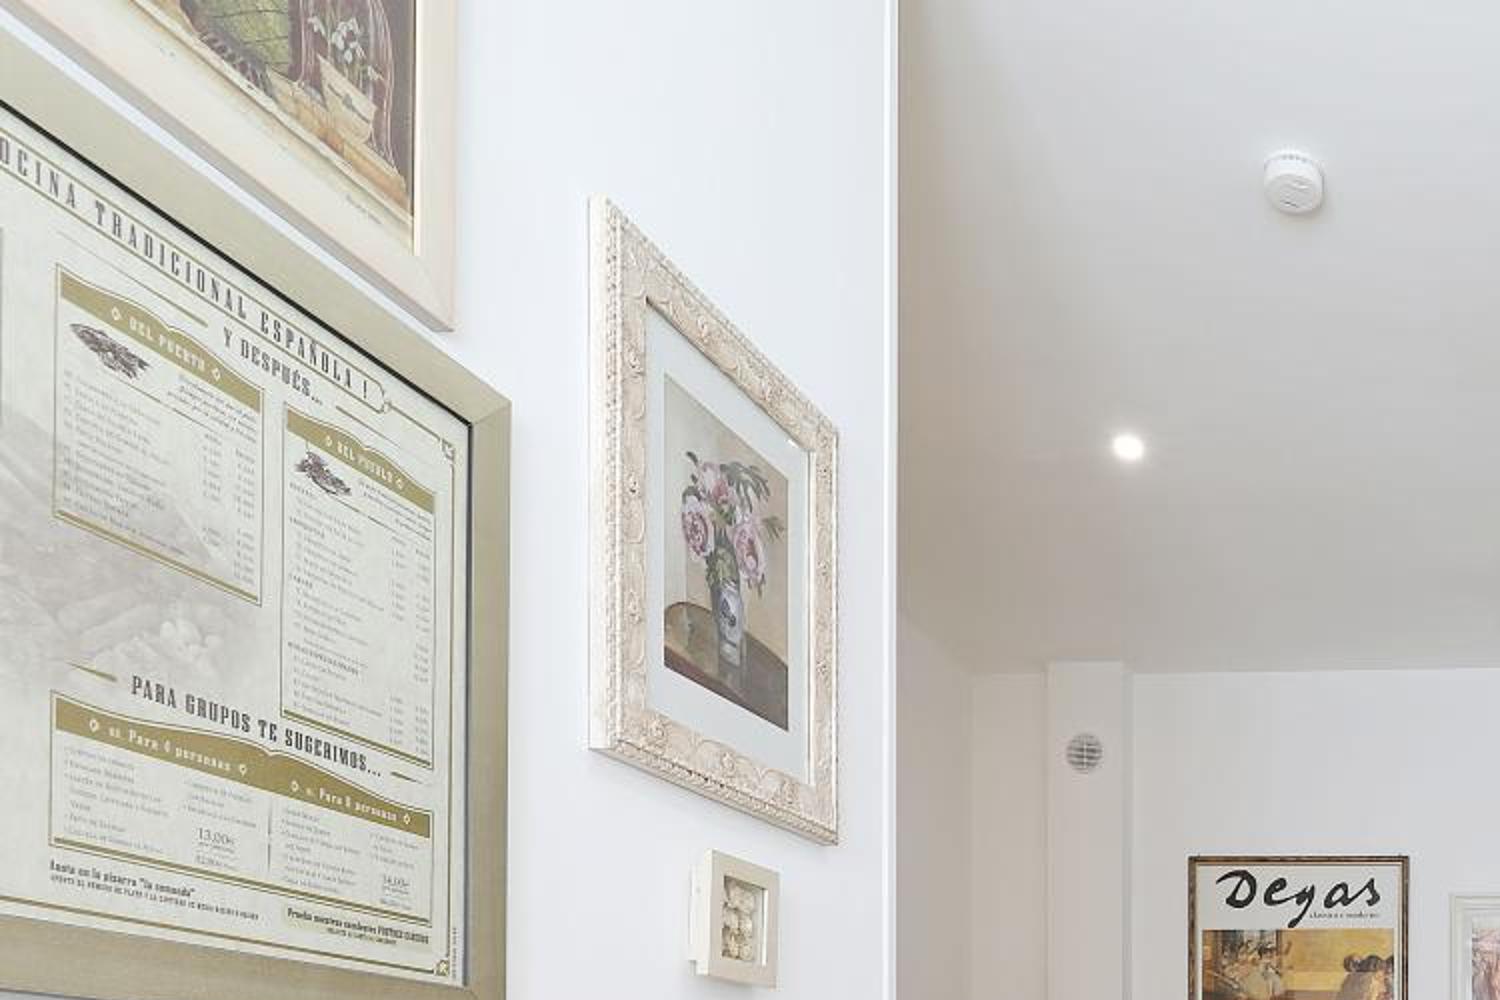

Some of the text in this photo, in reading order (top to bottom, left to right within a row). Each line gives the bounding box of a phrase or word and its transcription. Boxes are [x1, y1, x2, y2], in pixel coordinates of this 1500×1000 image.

[95, 200, 246, 319] TRADICIONAL
[260, 311, 352, 389] ESPAÑOLA
[223, 327, 233, 348] Y
[129, 728, 158, 751] Para
[131, 675, 381, 777] PARA GRUPOS TE SUGERIMOS...
[1215, 869, 1381, 928] Degas
